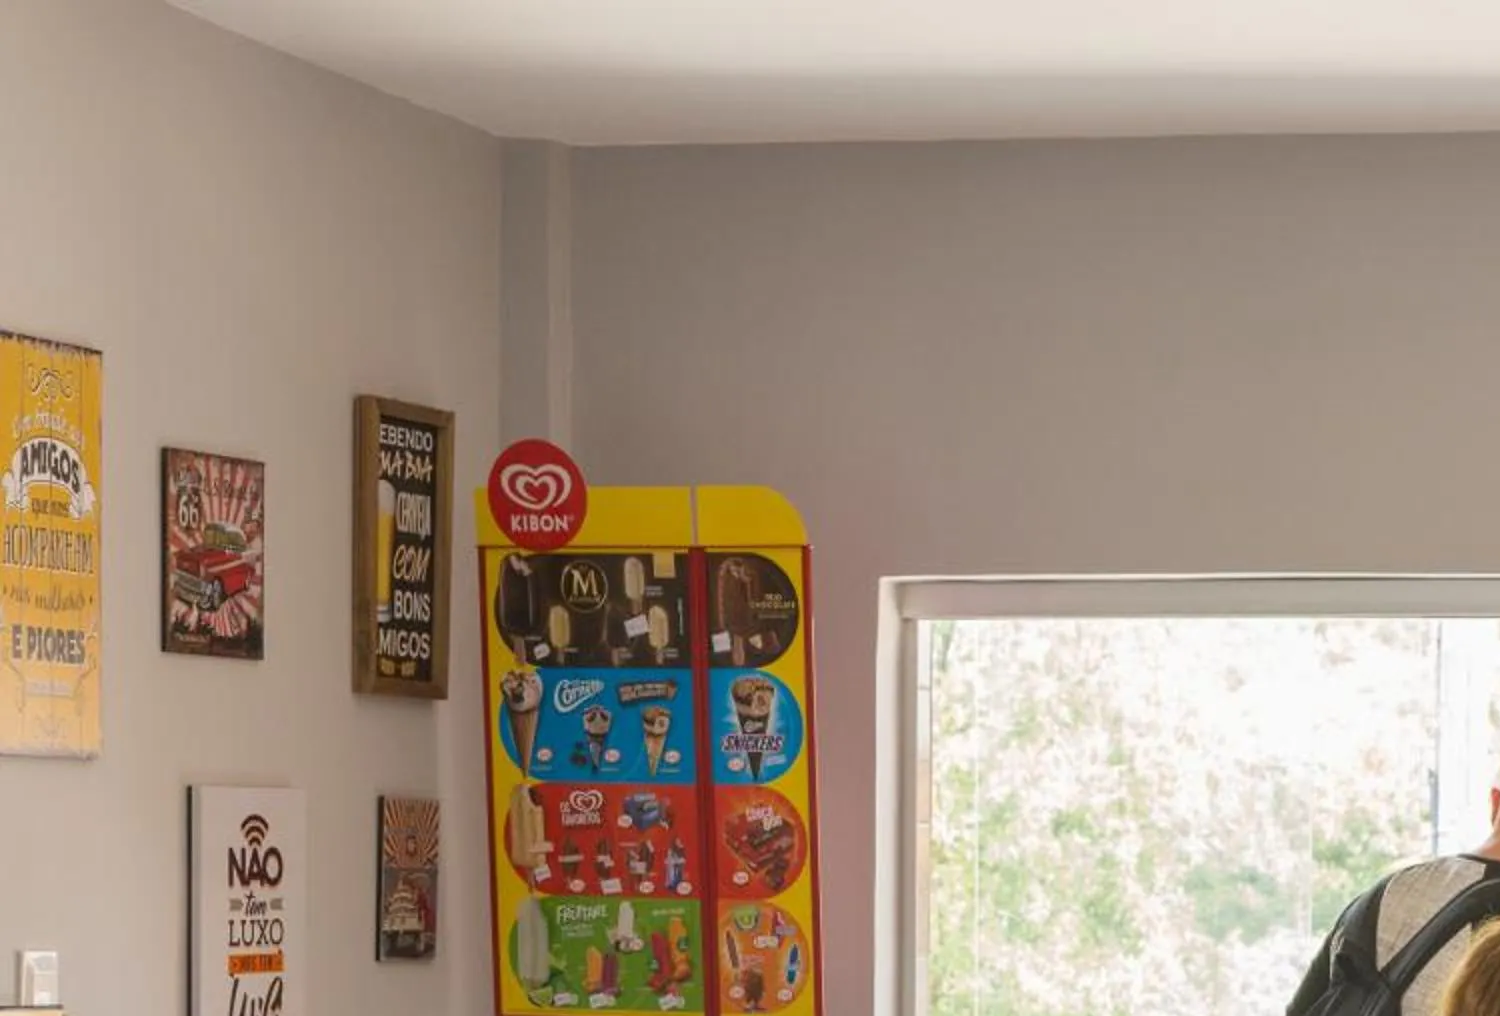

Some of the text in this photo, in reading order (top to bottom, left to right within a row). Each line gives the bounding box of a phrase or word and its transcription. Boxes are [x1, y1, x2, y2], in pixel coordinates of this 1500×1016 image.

[379, 424, 433, 452] EBENDO
[20, 441, 80, 494] AMIGOS
[378, 450, 403, 478] MA
[179, 496, 198, 528] 66
[511, 514, 569, 533] KIBON
[393, 545, 430, 582] COM
[571, 569, 598, 597] M
[394, 590, 431, 622] BONS
[12, 624, 85, 664] E PIORES
[375, 628, 430, 660] MIGOS
[228, 919, 284, 947] LUXO
